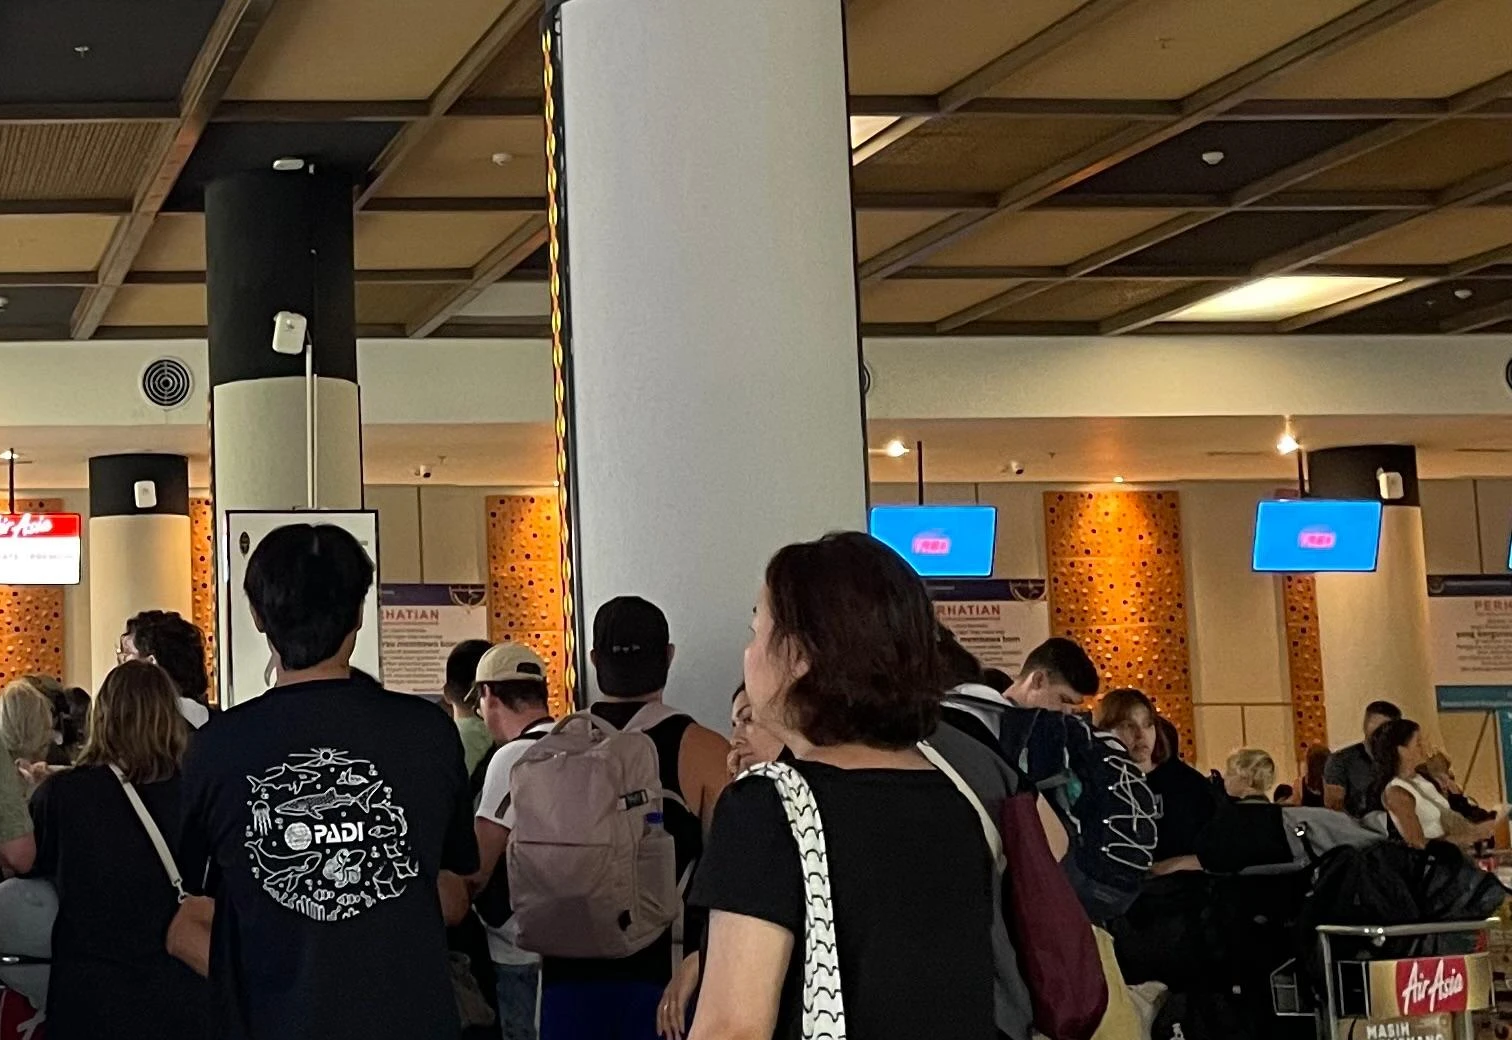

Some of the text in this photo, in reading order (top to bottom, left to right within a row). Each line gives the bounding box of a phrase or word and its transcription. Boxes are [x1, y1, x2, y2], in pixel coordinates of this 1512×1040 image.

[381, 608, 440, 620] HATIAN
[936, 604, 1001, 616] RHATIAN
[314, 822, 365, 844] PADI
[1366, 1022, 1410, 1040] MASIH
